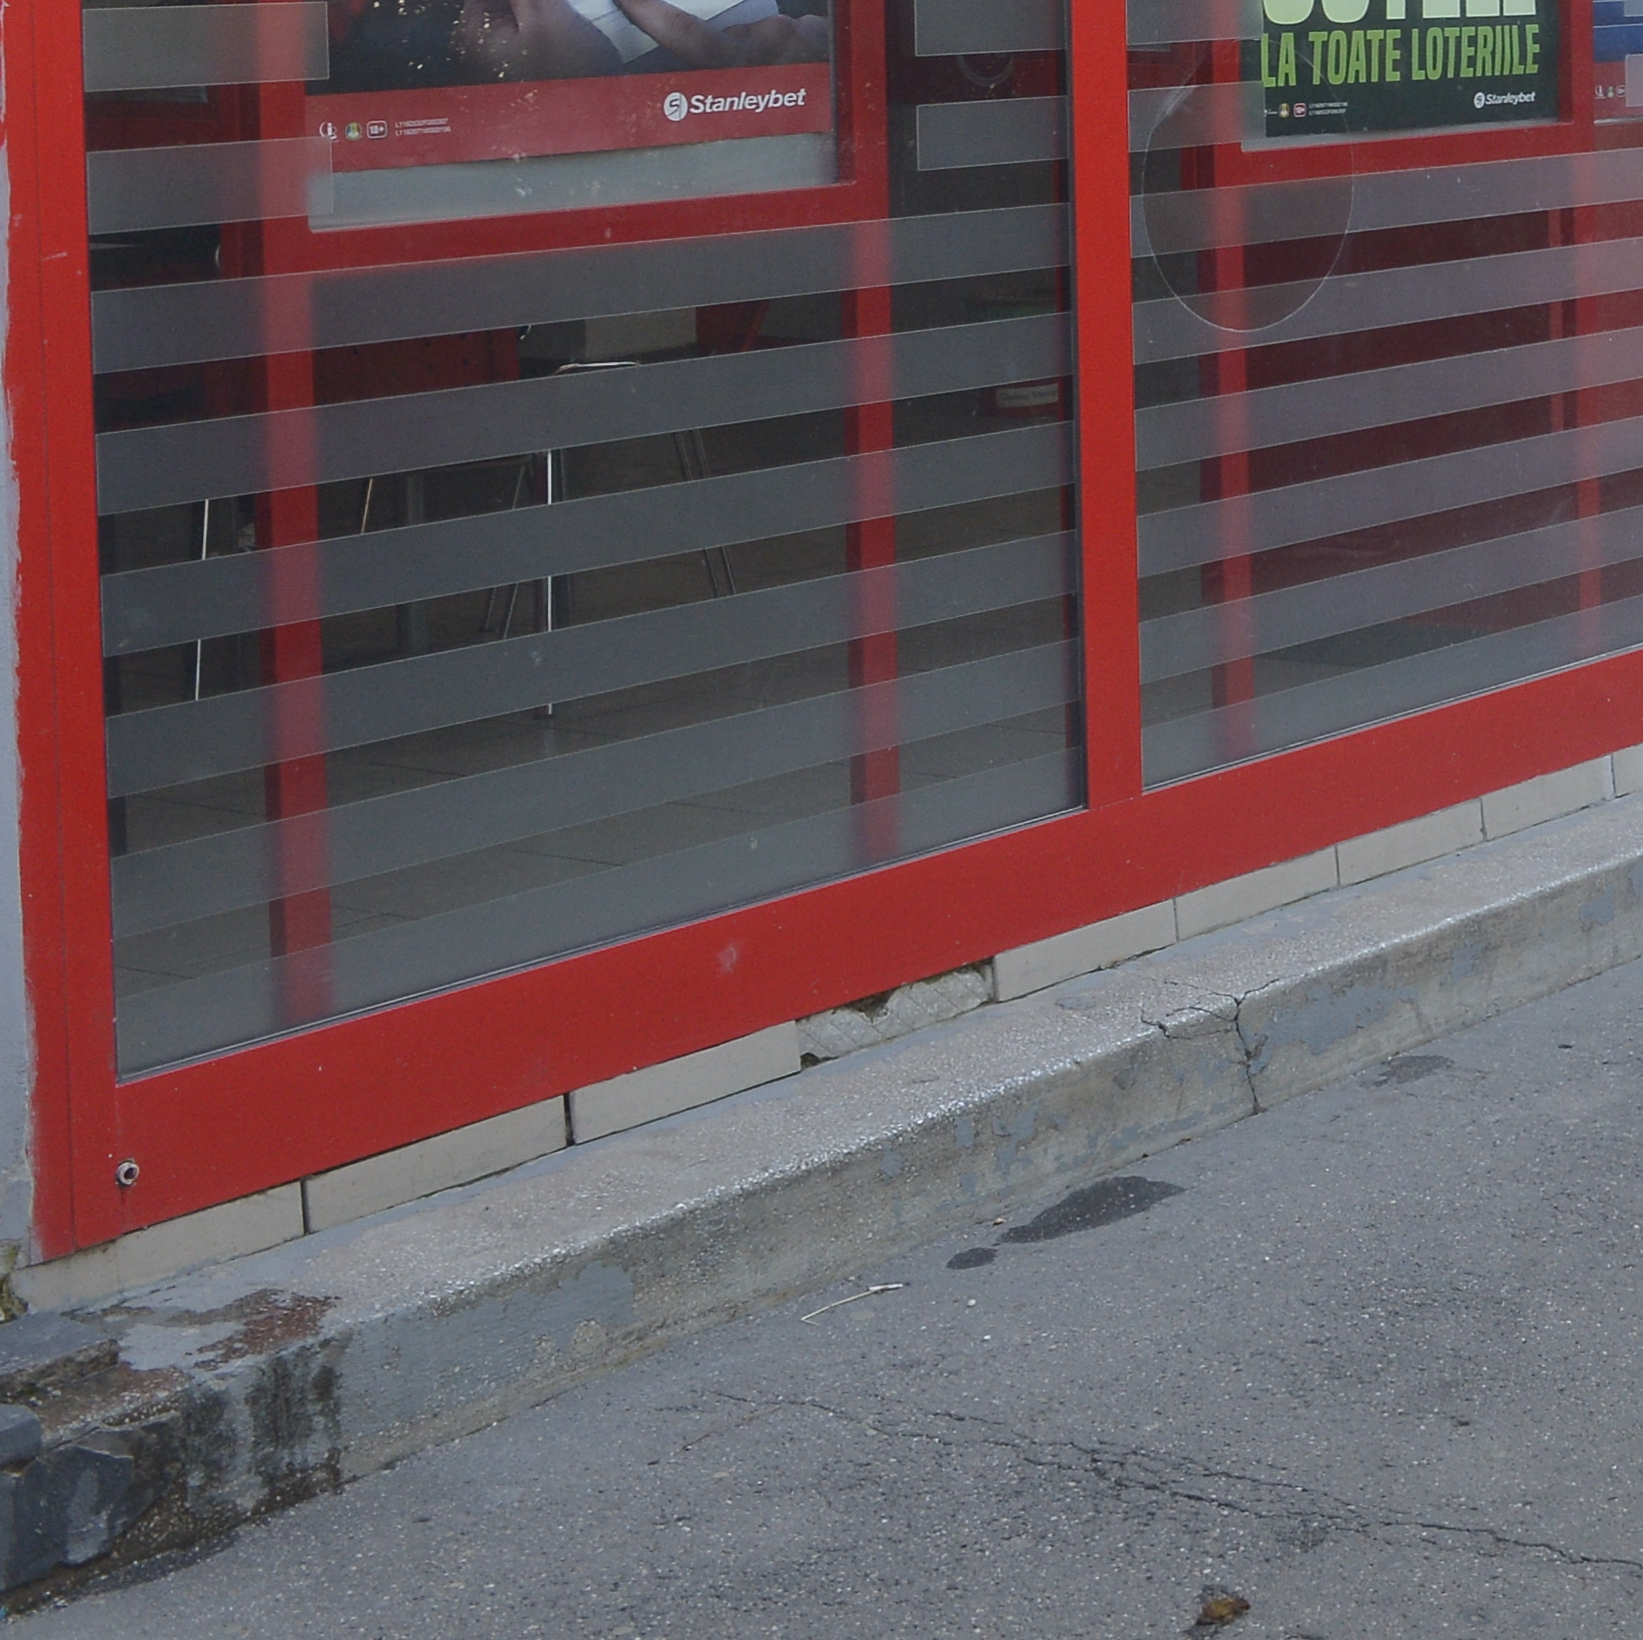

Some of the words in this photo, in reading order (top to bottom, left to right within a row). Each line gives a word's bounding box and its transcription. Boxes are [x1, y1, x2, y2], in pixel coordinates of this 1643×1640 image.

[1261, 32, 1297, 87] LA
[1308, 29, 1401, 86] TOATE
[1411, 24, 1540, 81] LOTERIILE
[688, 86, 807, 114] Stanleybet
[1485, 91, 1537, 106] Stanleybet
